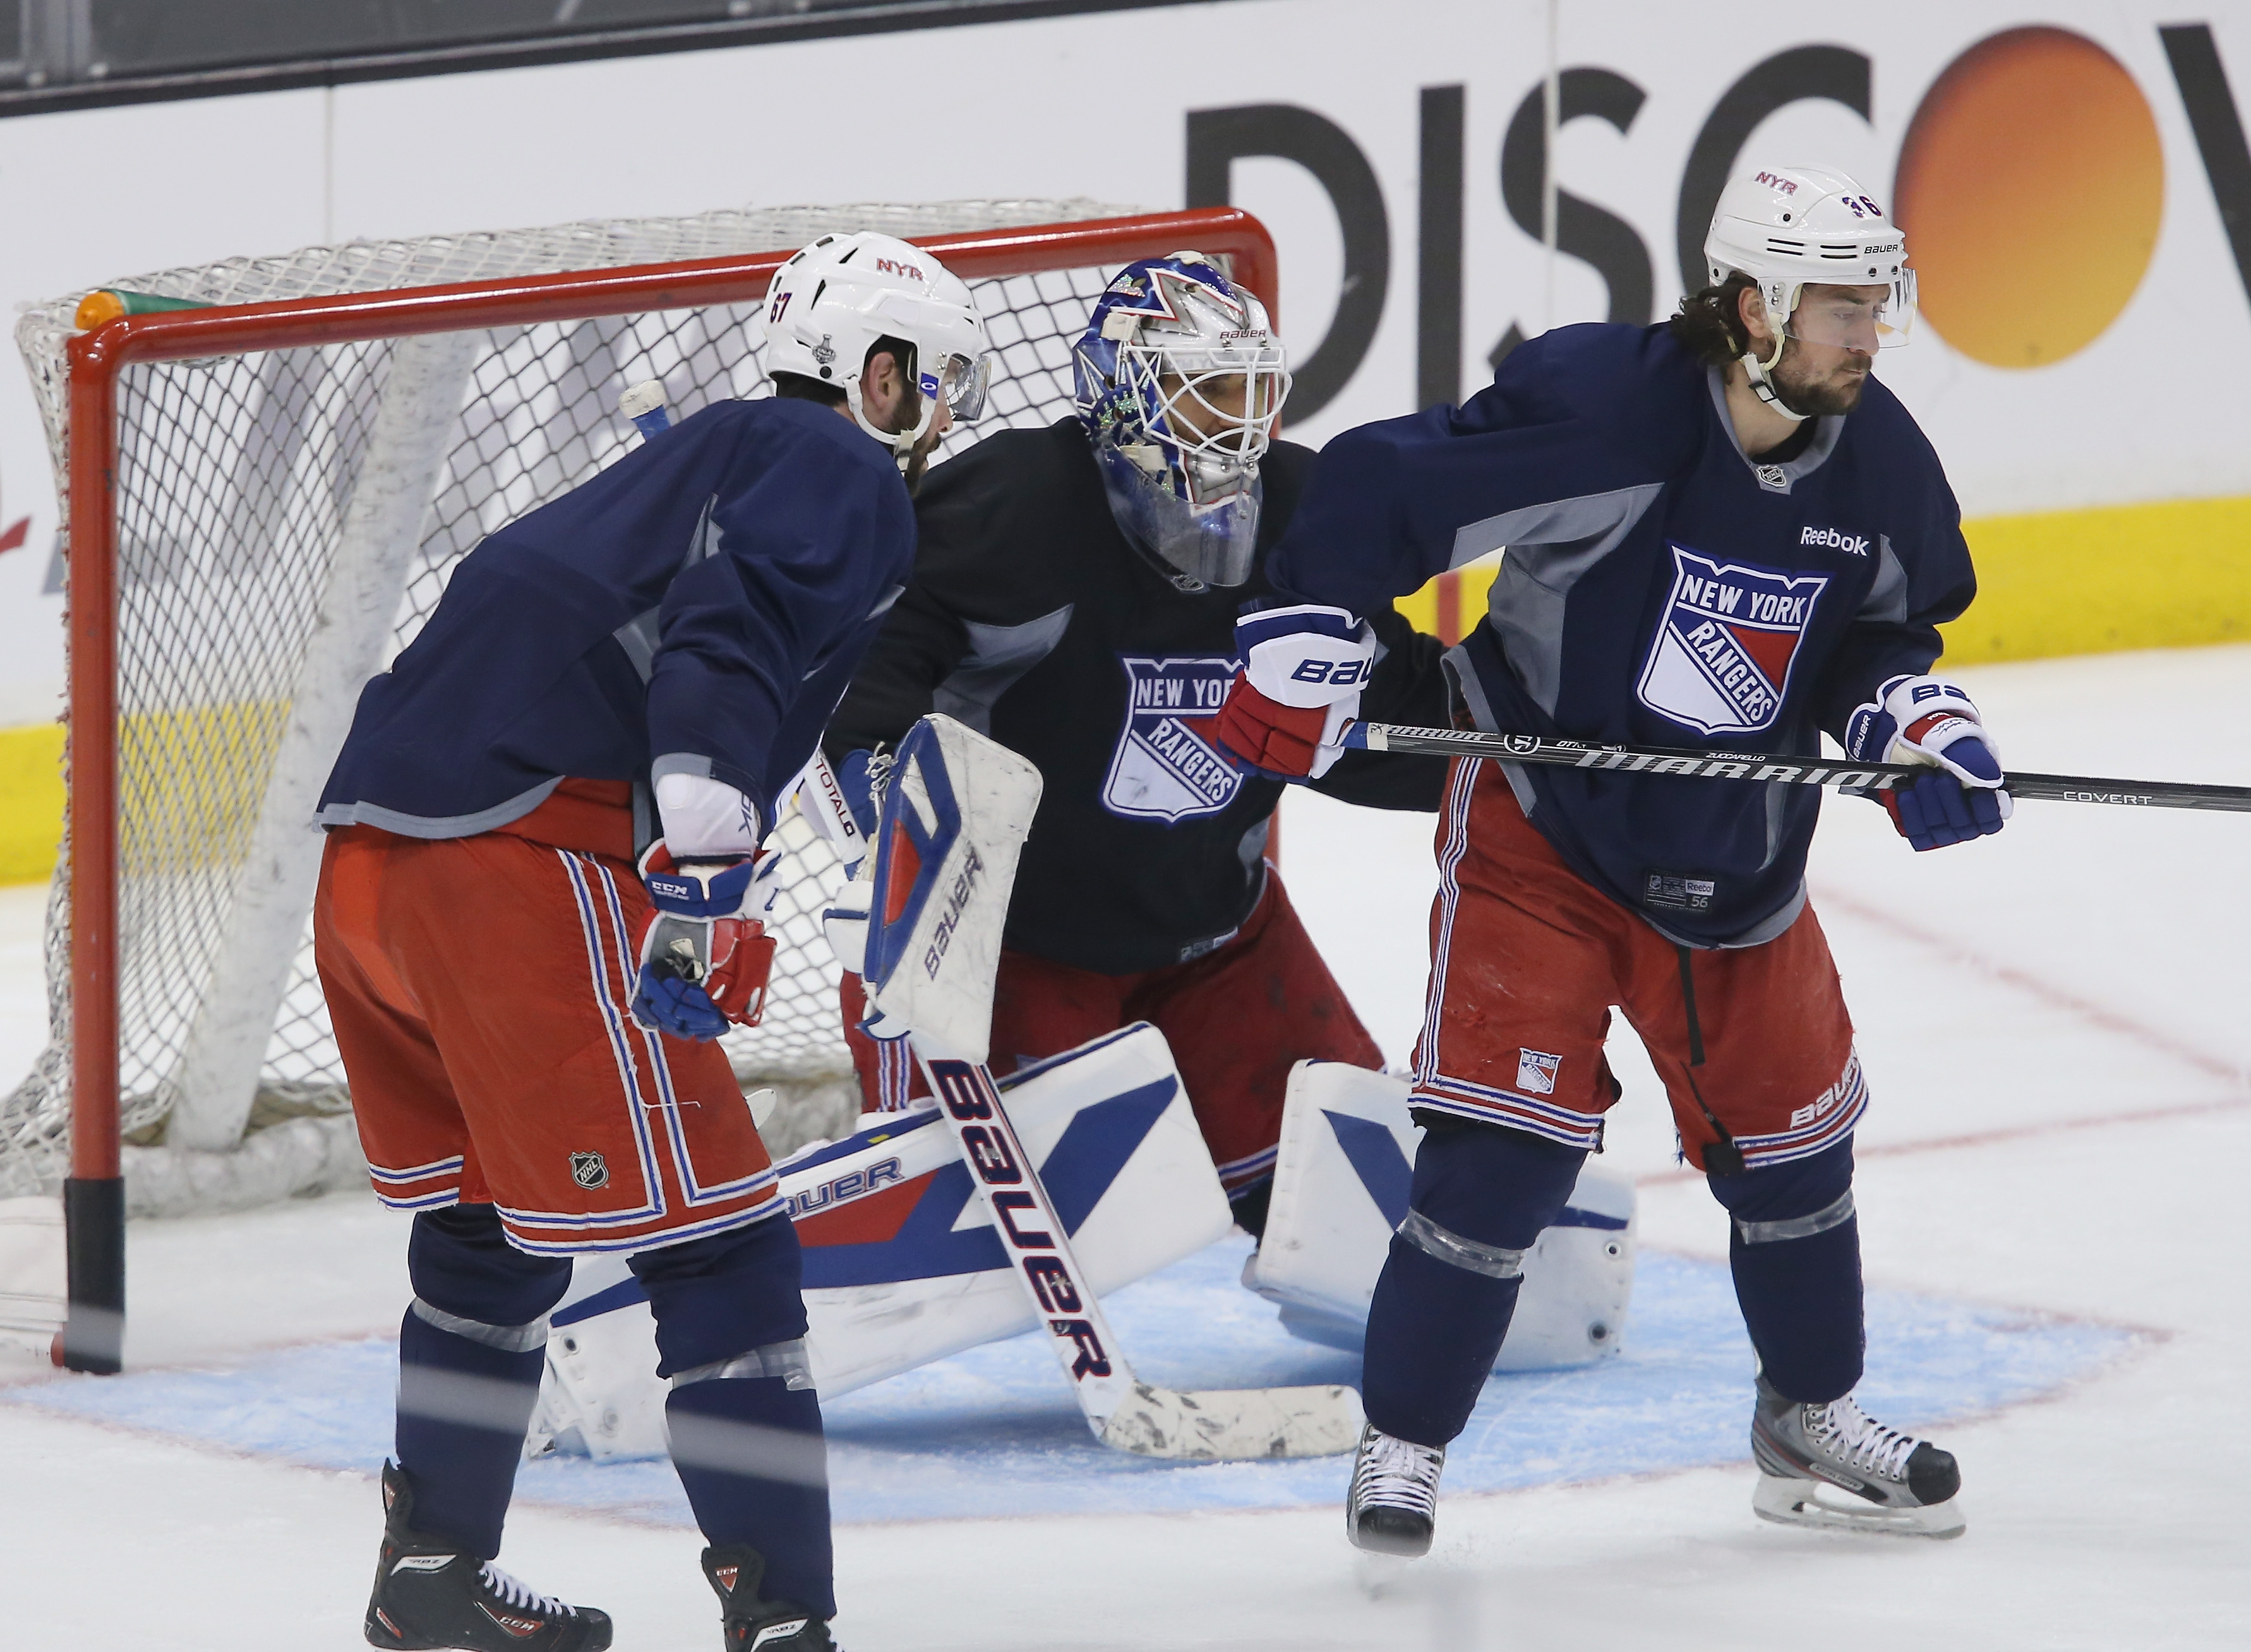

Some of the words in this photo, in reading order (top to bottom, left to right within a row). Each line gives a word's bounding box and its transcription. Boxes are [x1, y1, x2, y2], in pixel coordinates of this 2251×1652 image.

[1755, 171, 1798, 195] NYR
[1842, 195, 1882, 218] 36
[1864, 244, 1899, 254] BAUER
[876, 258, 923, 282] NYR
[770, 292, 793, 324] 67
[1219, 328, 1267, 339] BAUER
[1799, 525, 1870, 558] Reebok
[1679, 573, 1744, 615] NEW
[1748, 591, 1808, 624] YORK
[1686, 620, 1774, 723] RANGERS
[1136, 678, 1185, 707] NEW
[1852, 714, 1871, 758] BAUER
[1147, 718, 1234, 802] RANGERS
[1705, 752, 1767, 762] ZUCCARELLO
[2063, 791, 2153, 806] COVERT
[651, 880, 688, 895] CCM
[923, 841, 985, 981] BAUER
[1691, 895, 1708, 908] 56
[1523, 1053, 1539, 1063] NEW
[1539, 1056, 1556, 1068] YORK
[1525, 1063, 1551, 1091] RANGERS
[579, 1160, 599, 1182] NHL
[927, 1059, 1113, 1382] BAUER
[716, 1567, 739, 1577] CCM
[500, 1616, 536, 1632] CCM
